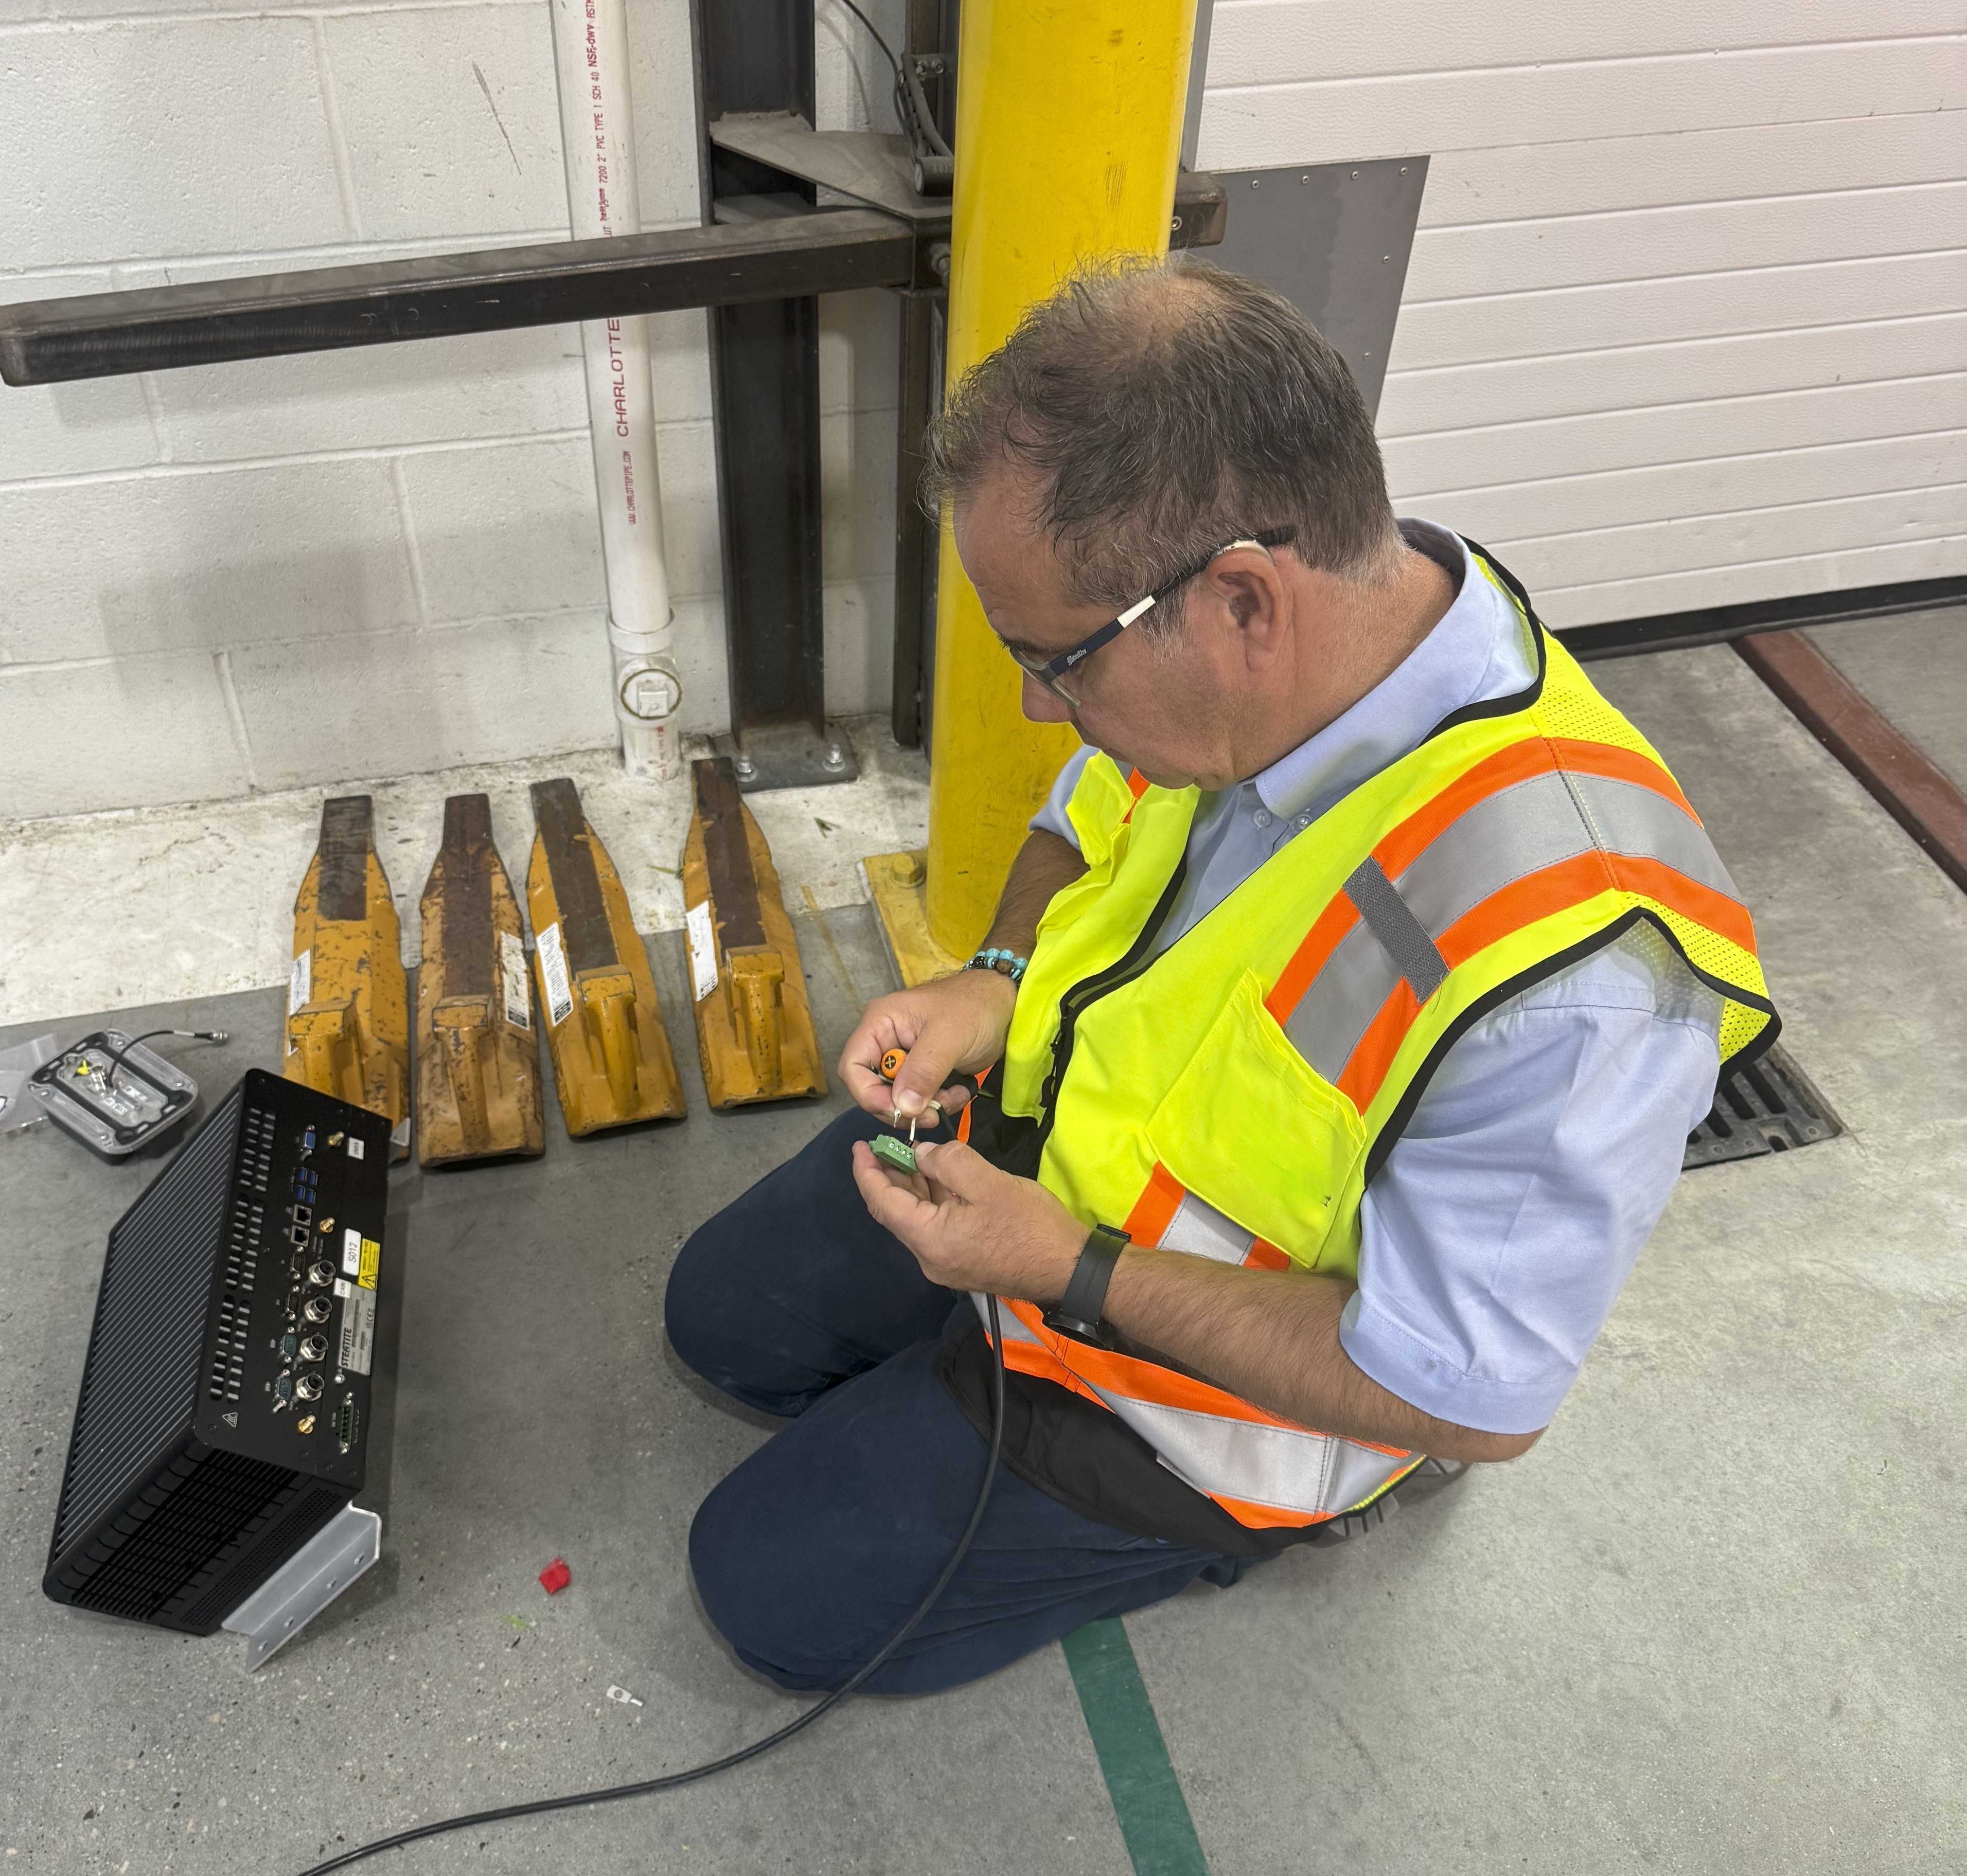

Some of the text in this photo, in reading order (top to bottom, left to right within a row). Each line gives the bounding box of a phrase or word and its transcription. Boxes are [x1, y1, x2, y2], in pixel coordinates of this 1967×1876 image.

[591, 72, 599, 81] 40
[592, 86, 601, 100] SCH
[594, 113, 603, 130] TYPE
[596, 136, 605, 149] PVC
[599, 166, 607, 183] 7200
[607, 319, 629, 437] CHARLOTTE
[349, 1242, 357, 1263] S012
[341, 1327, 352, 1367] STEATITE
